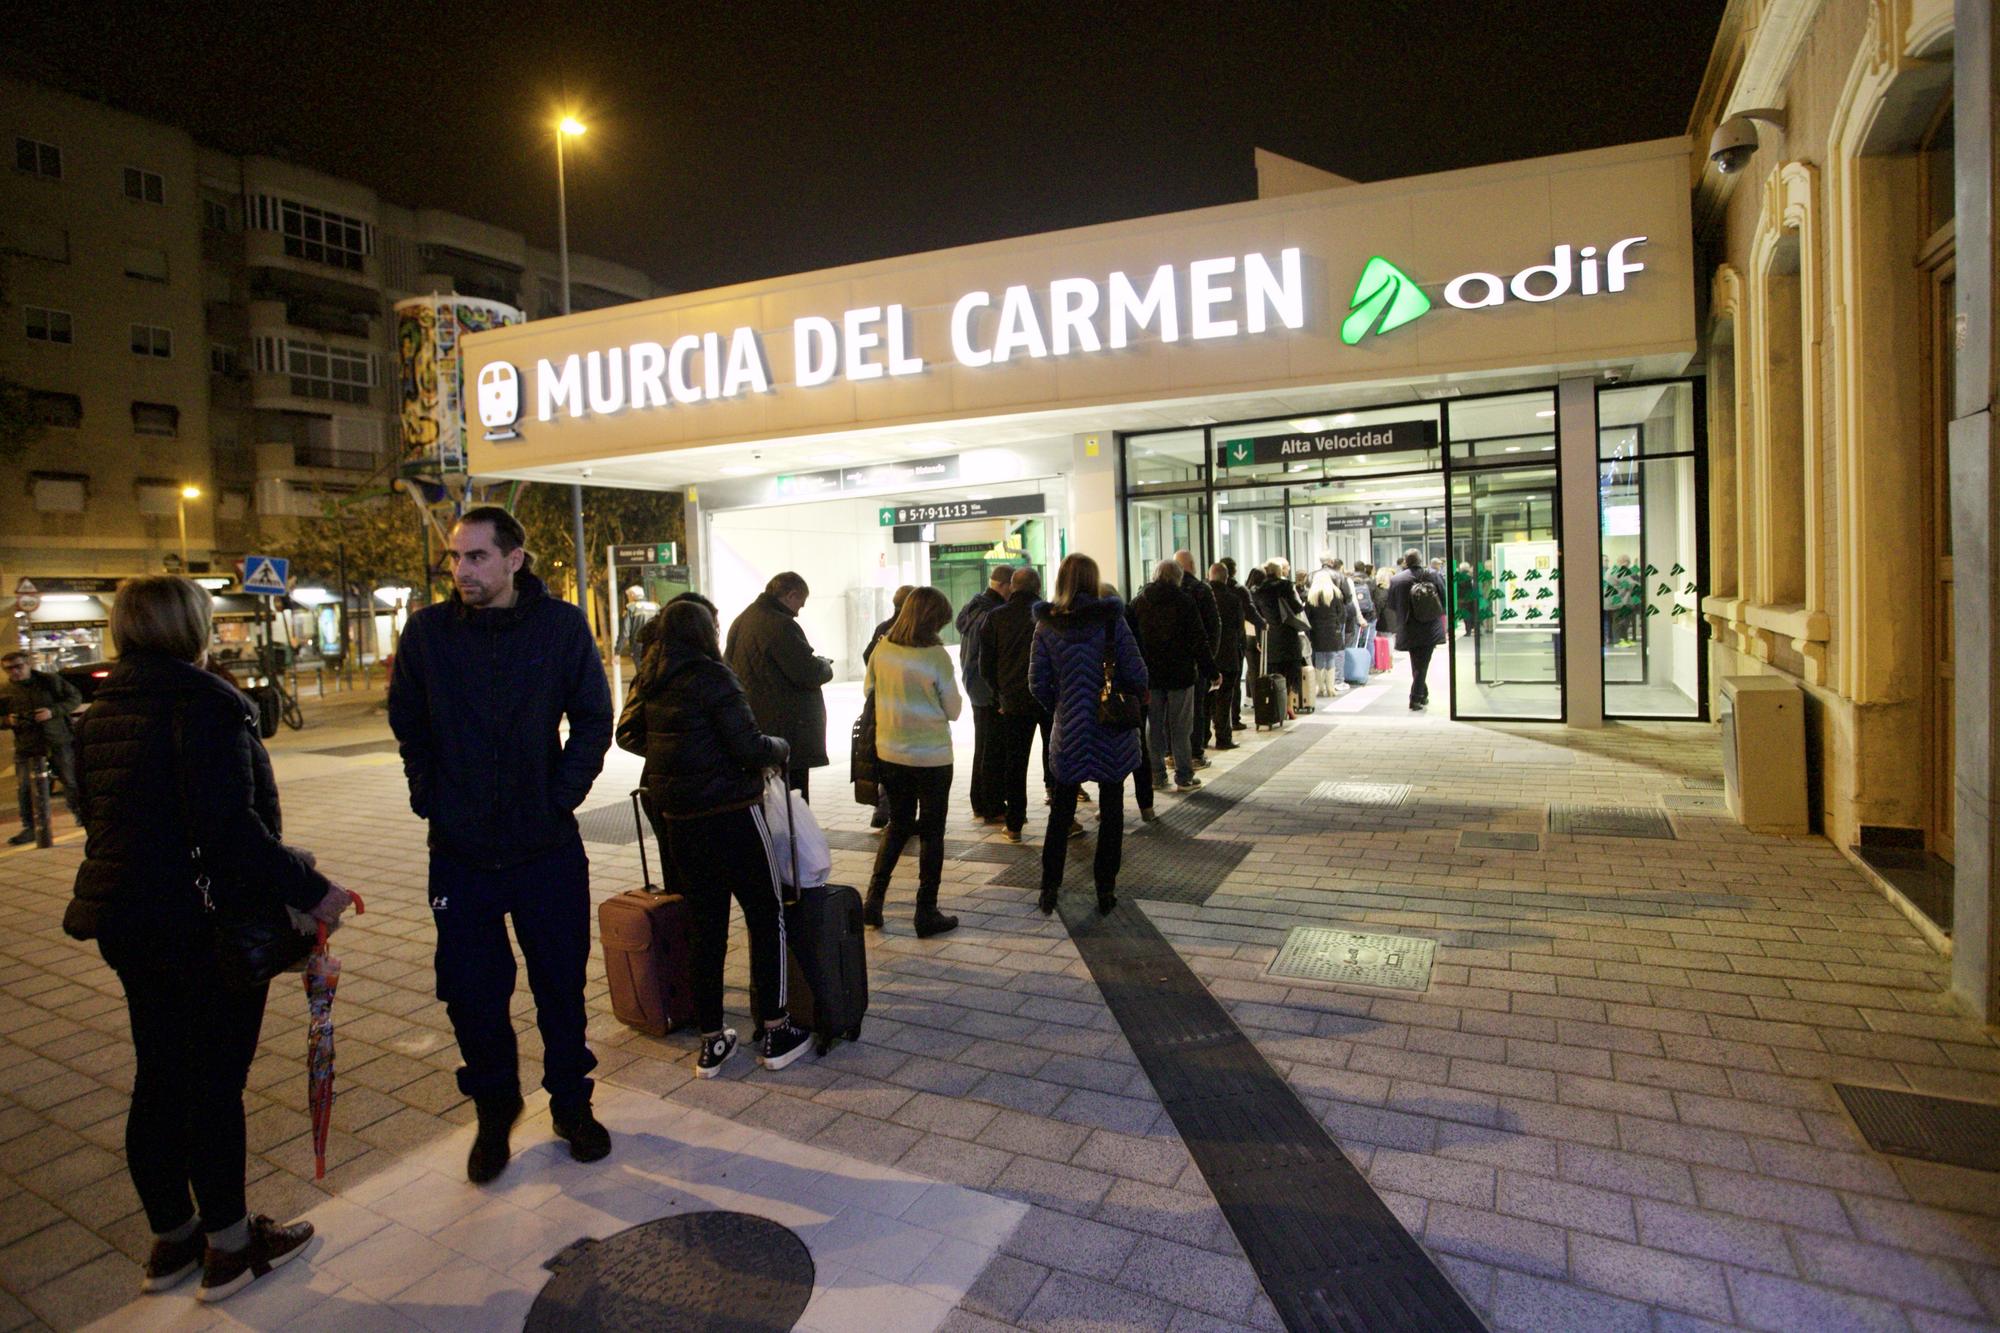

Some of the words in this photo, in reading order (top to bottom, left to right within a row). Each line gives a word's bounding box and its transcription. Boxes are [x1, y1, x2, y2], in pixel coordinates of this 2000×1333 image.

[1444, 236, 1648, 310] adif
[537, 326, 768, 423] MURCIA
[793, 303, 924, 388] DEL
[951, 247, 1305, 368] CARMEN
[1281, 439, 1311, 454] Alta
[1315, 429, 1393, 451] Velocidad
